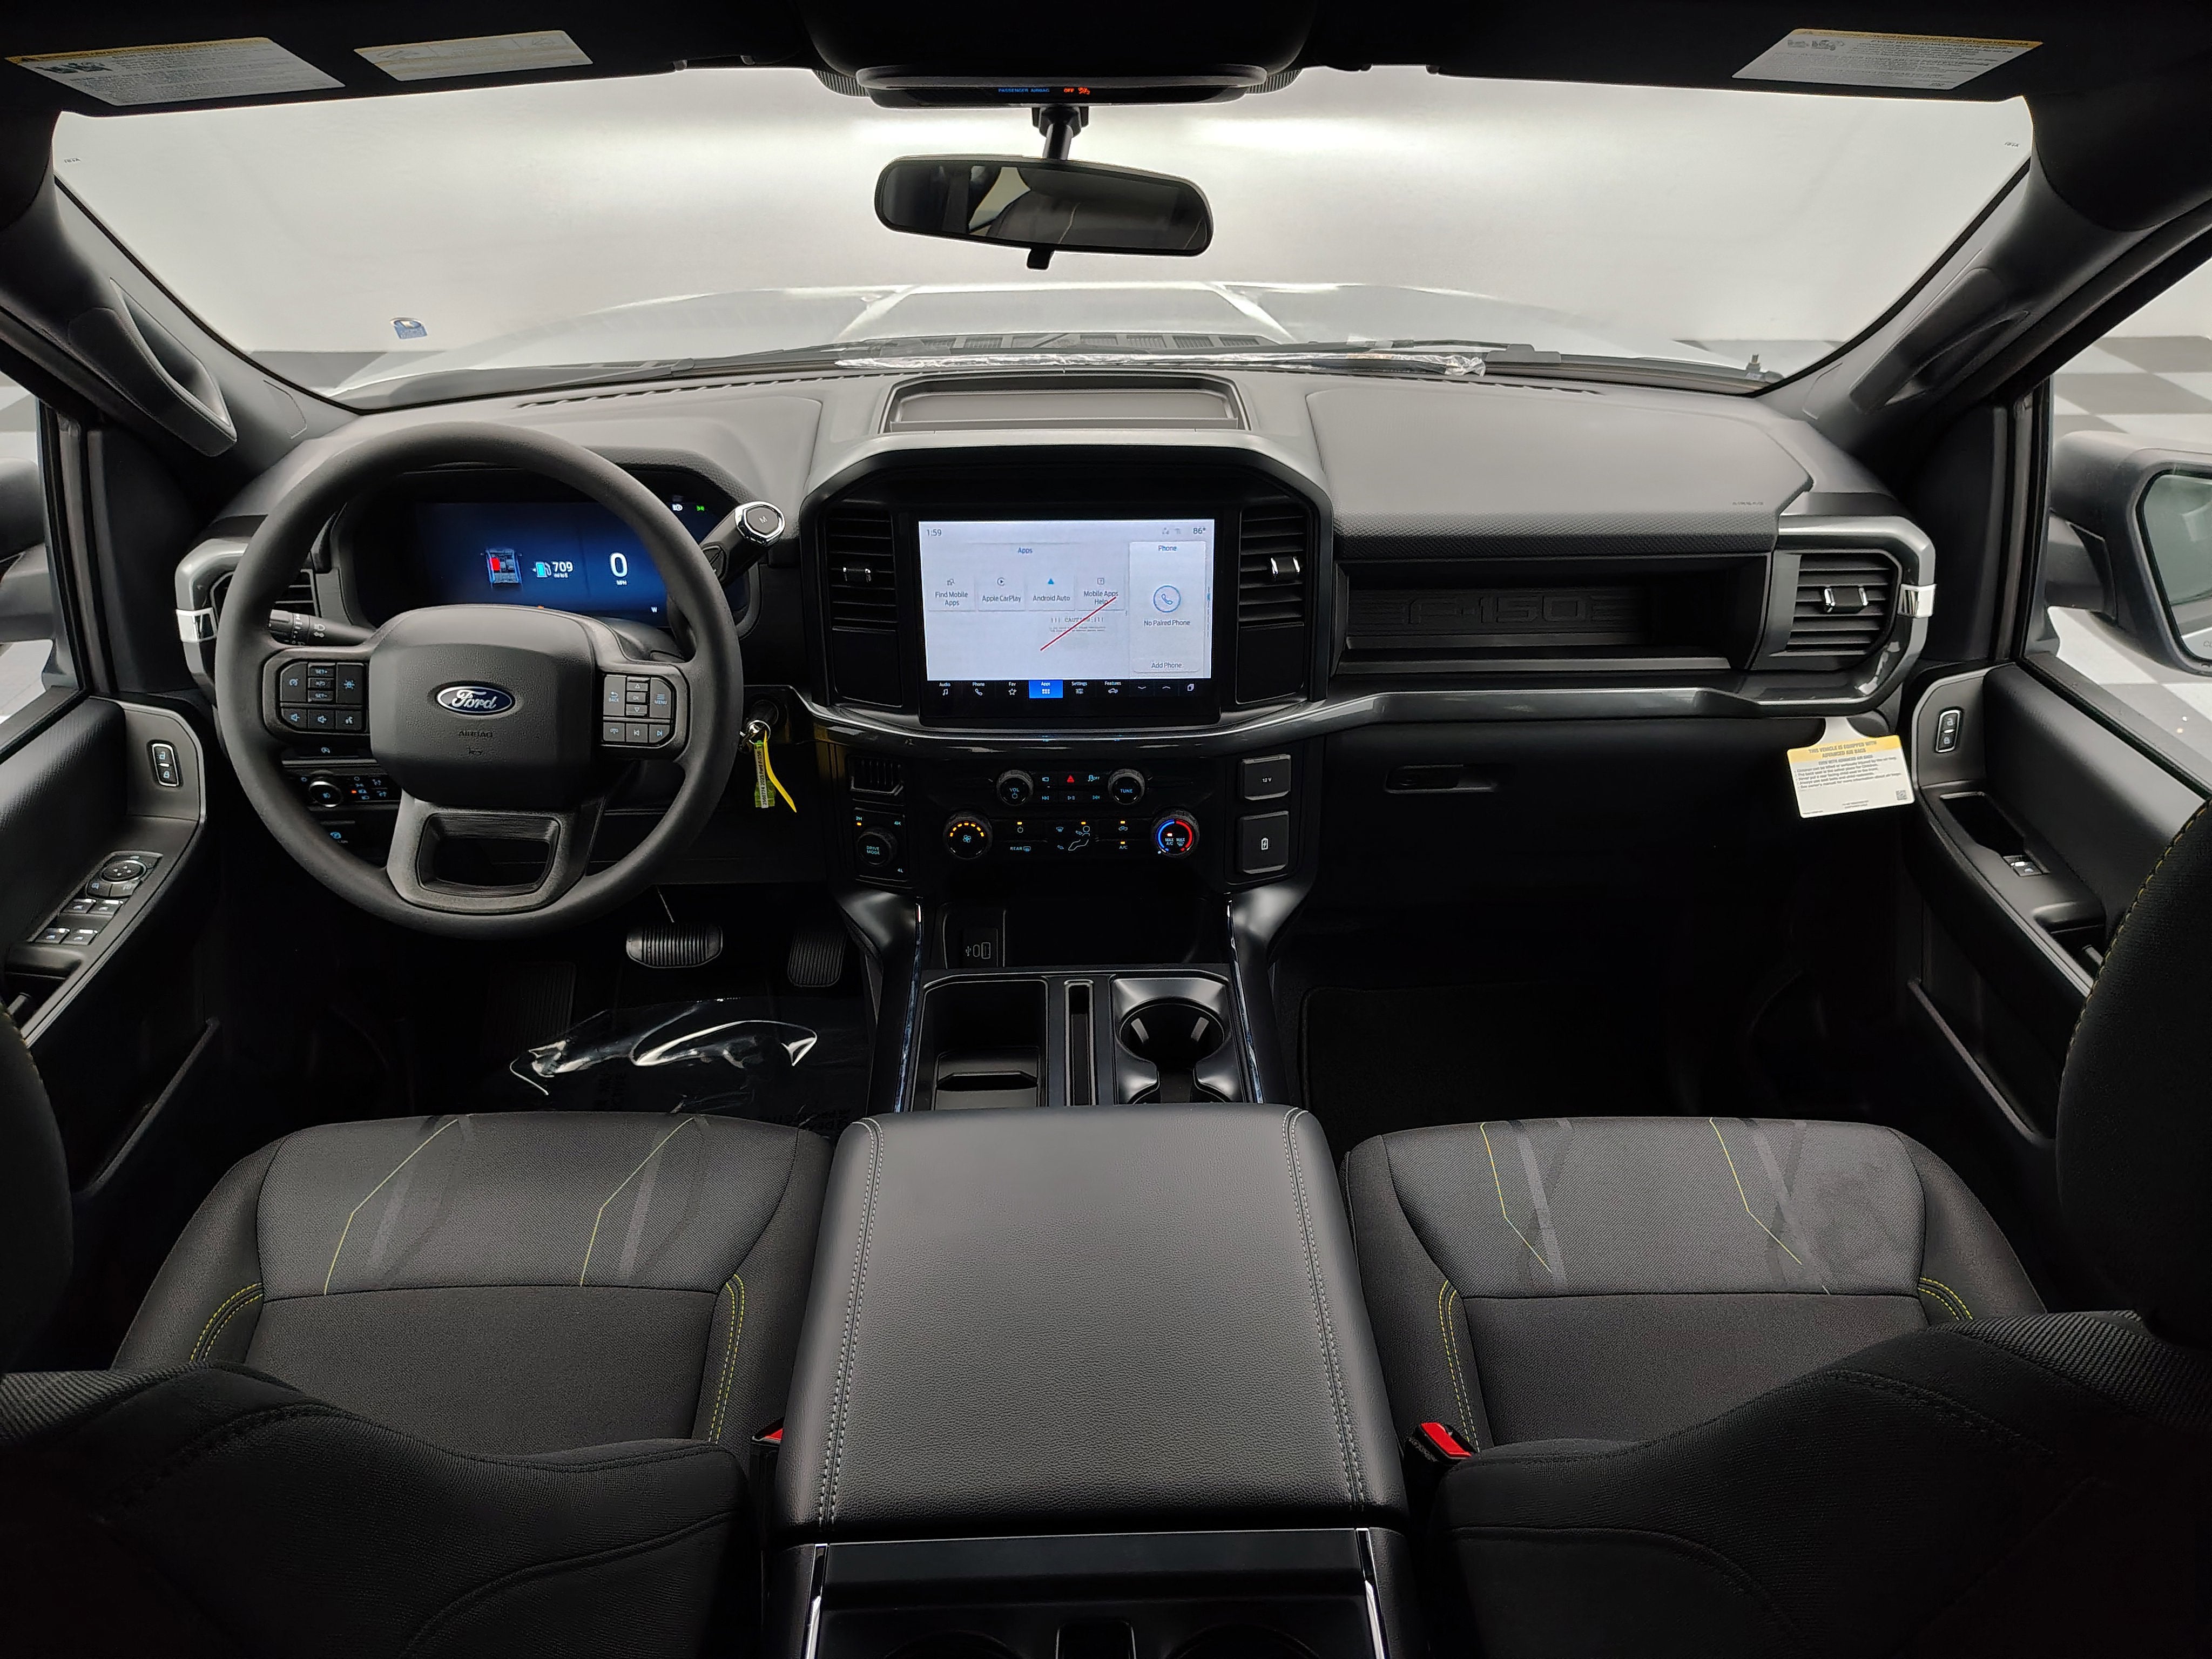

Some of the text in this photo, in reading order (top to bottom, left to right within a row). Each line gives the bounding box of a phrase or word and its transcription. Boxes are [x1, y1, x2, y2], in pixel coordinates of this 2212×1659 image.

[759, 516, 768, 524] M
[552, 562, 573, 572] 709
[610, 552, 628, 577] 0
[1408, 595, 1586, 624] F-150
[451, 689, 497, 709] Ford
